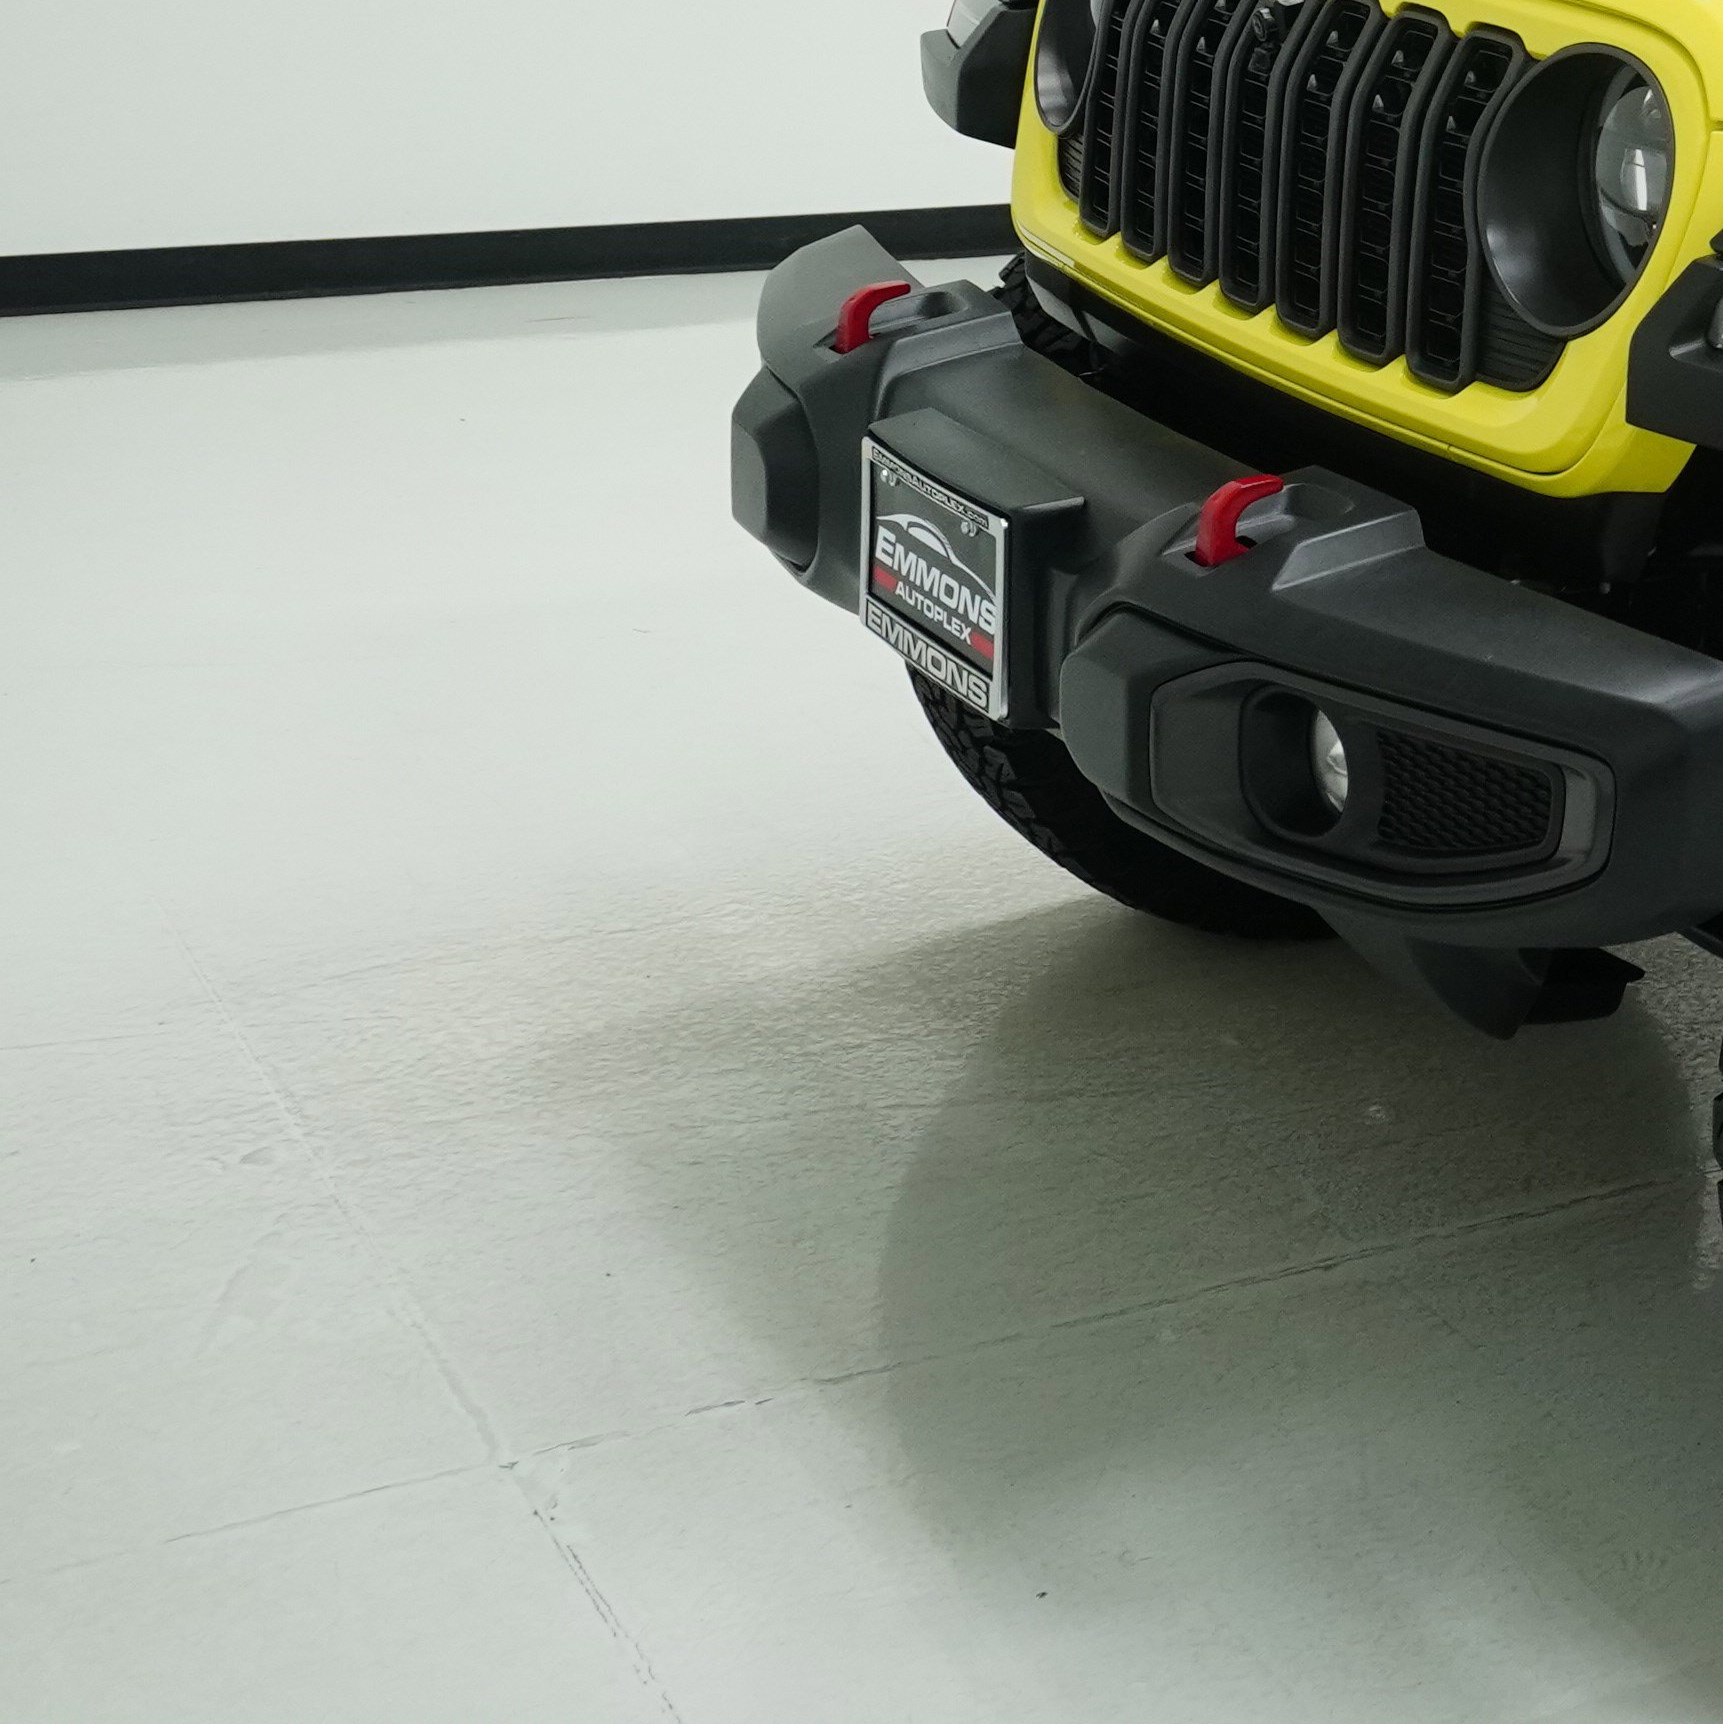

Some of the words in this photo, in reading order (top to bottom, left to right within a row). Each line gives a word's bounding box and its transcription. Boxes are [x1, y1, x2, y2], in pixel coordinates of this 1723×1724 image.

[874, 525, 997, 636] EMMONS
[894, 579, 973, 646] AUTOPLEX
[867, 606, 989, 709] EMMONS
